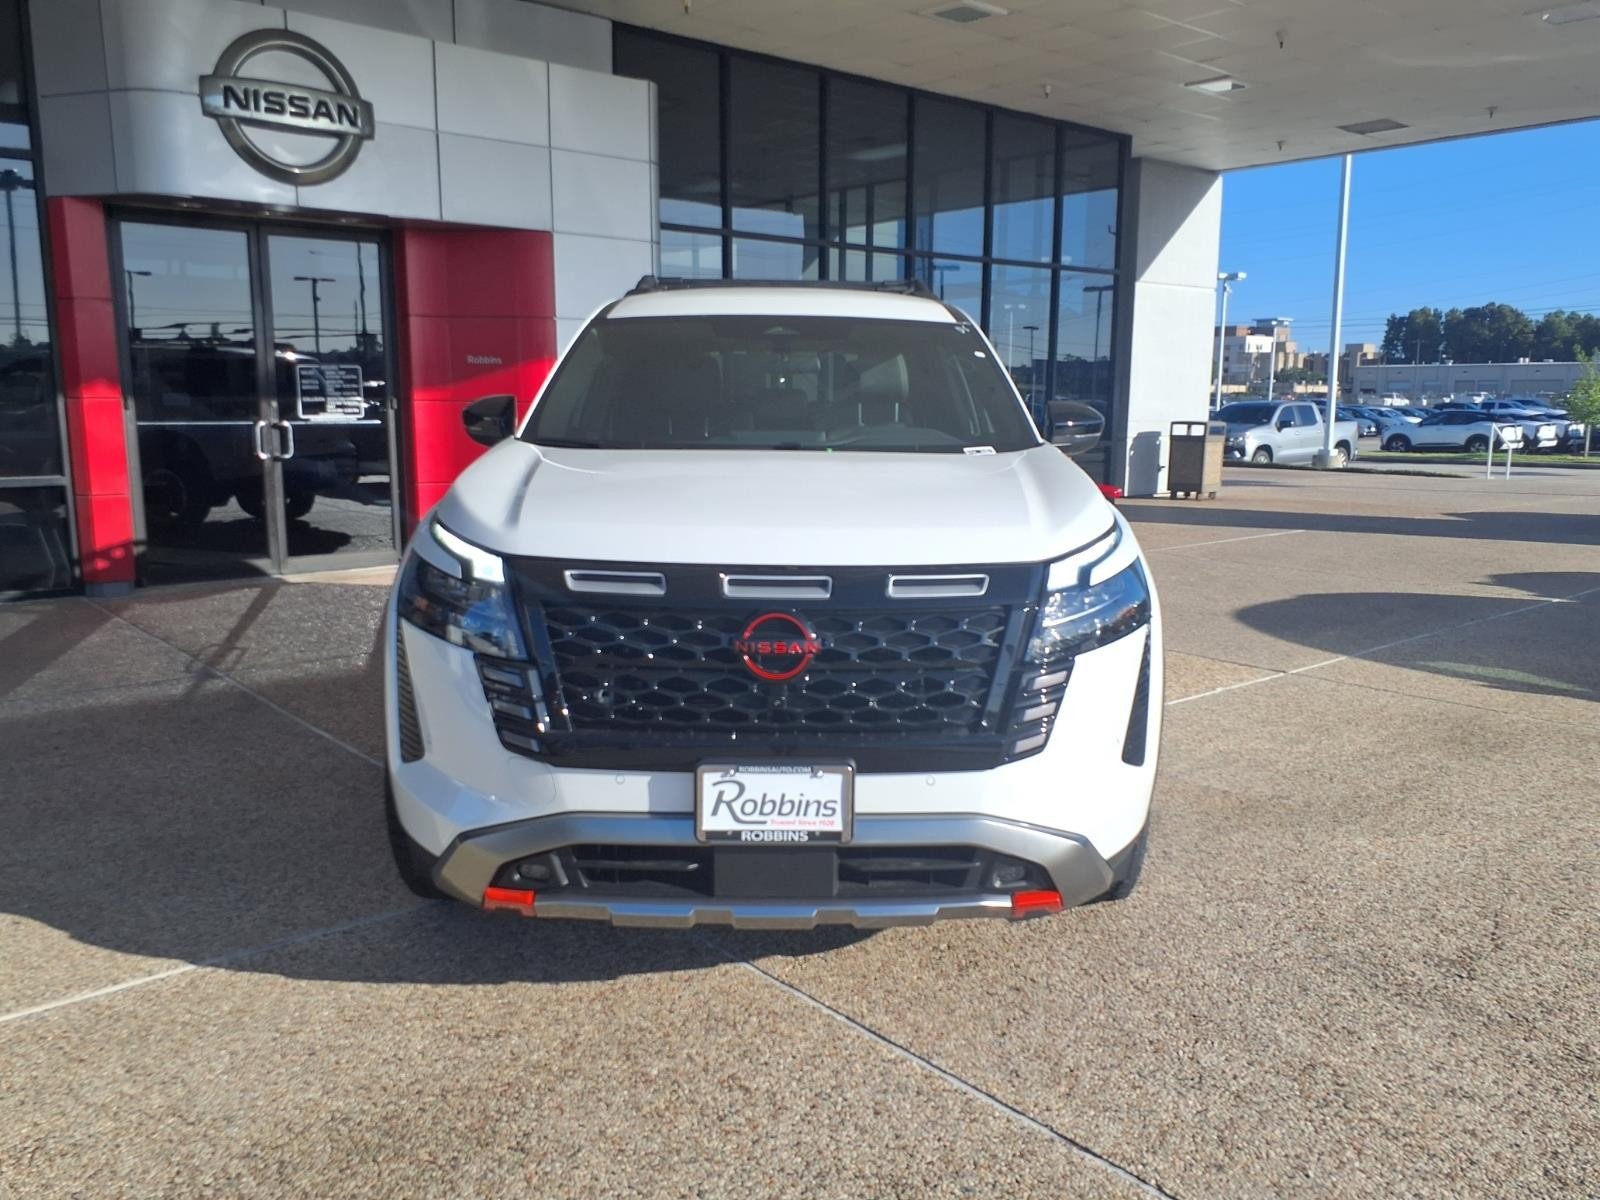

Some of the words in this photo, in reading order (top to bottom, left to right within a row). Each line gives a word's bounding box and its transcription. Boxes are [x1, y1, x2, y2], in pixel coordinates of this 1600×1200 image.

[222, 85, 361, 128] NISSAN
[467, 355, 503, 365] Robbins
[734, 639, 821, 654] NISSAN
[738, 765, 812, 774] ROBBINSAUTO.COM
[710, 780, 839, 825] Robbins
[741, 830, 809, 842] ROBBINS
